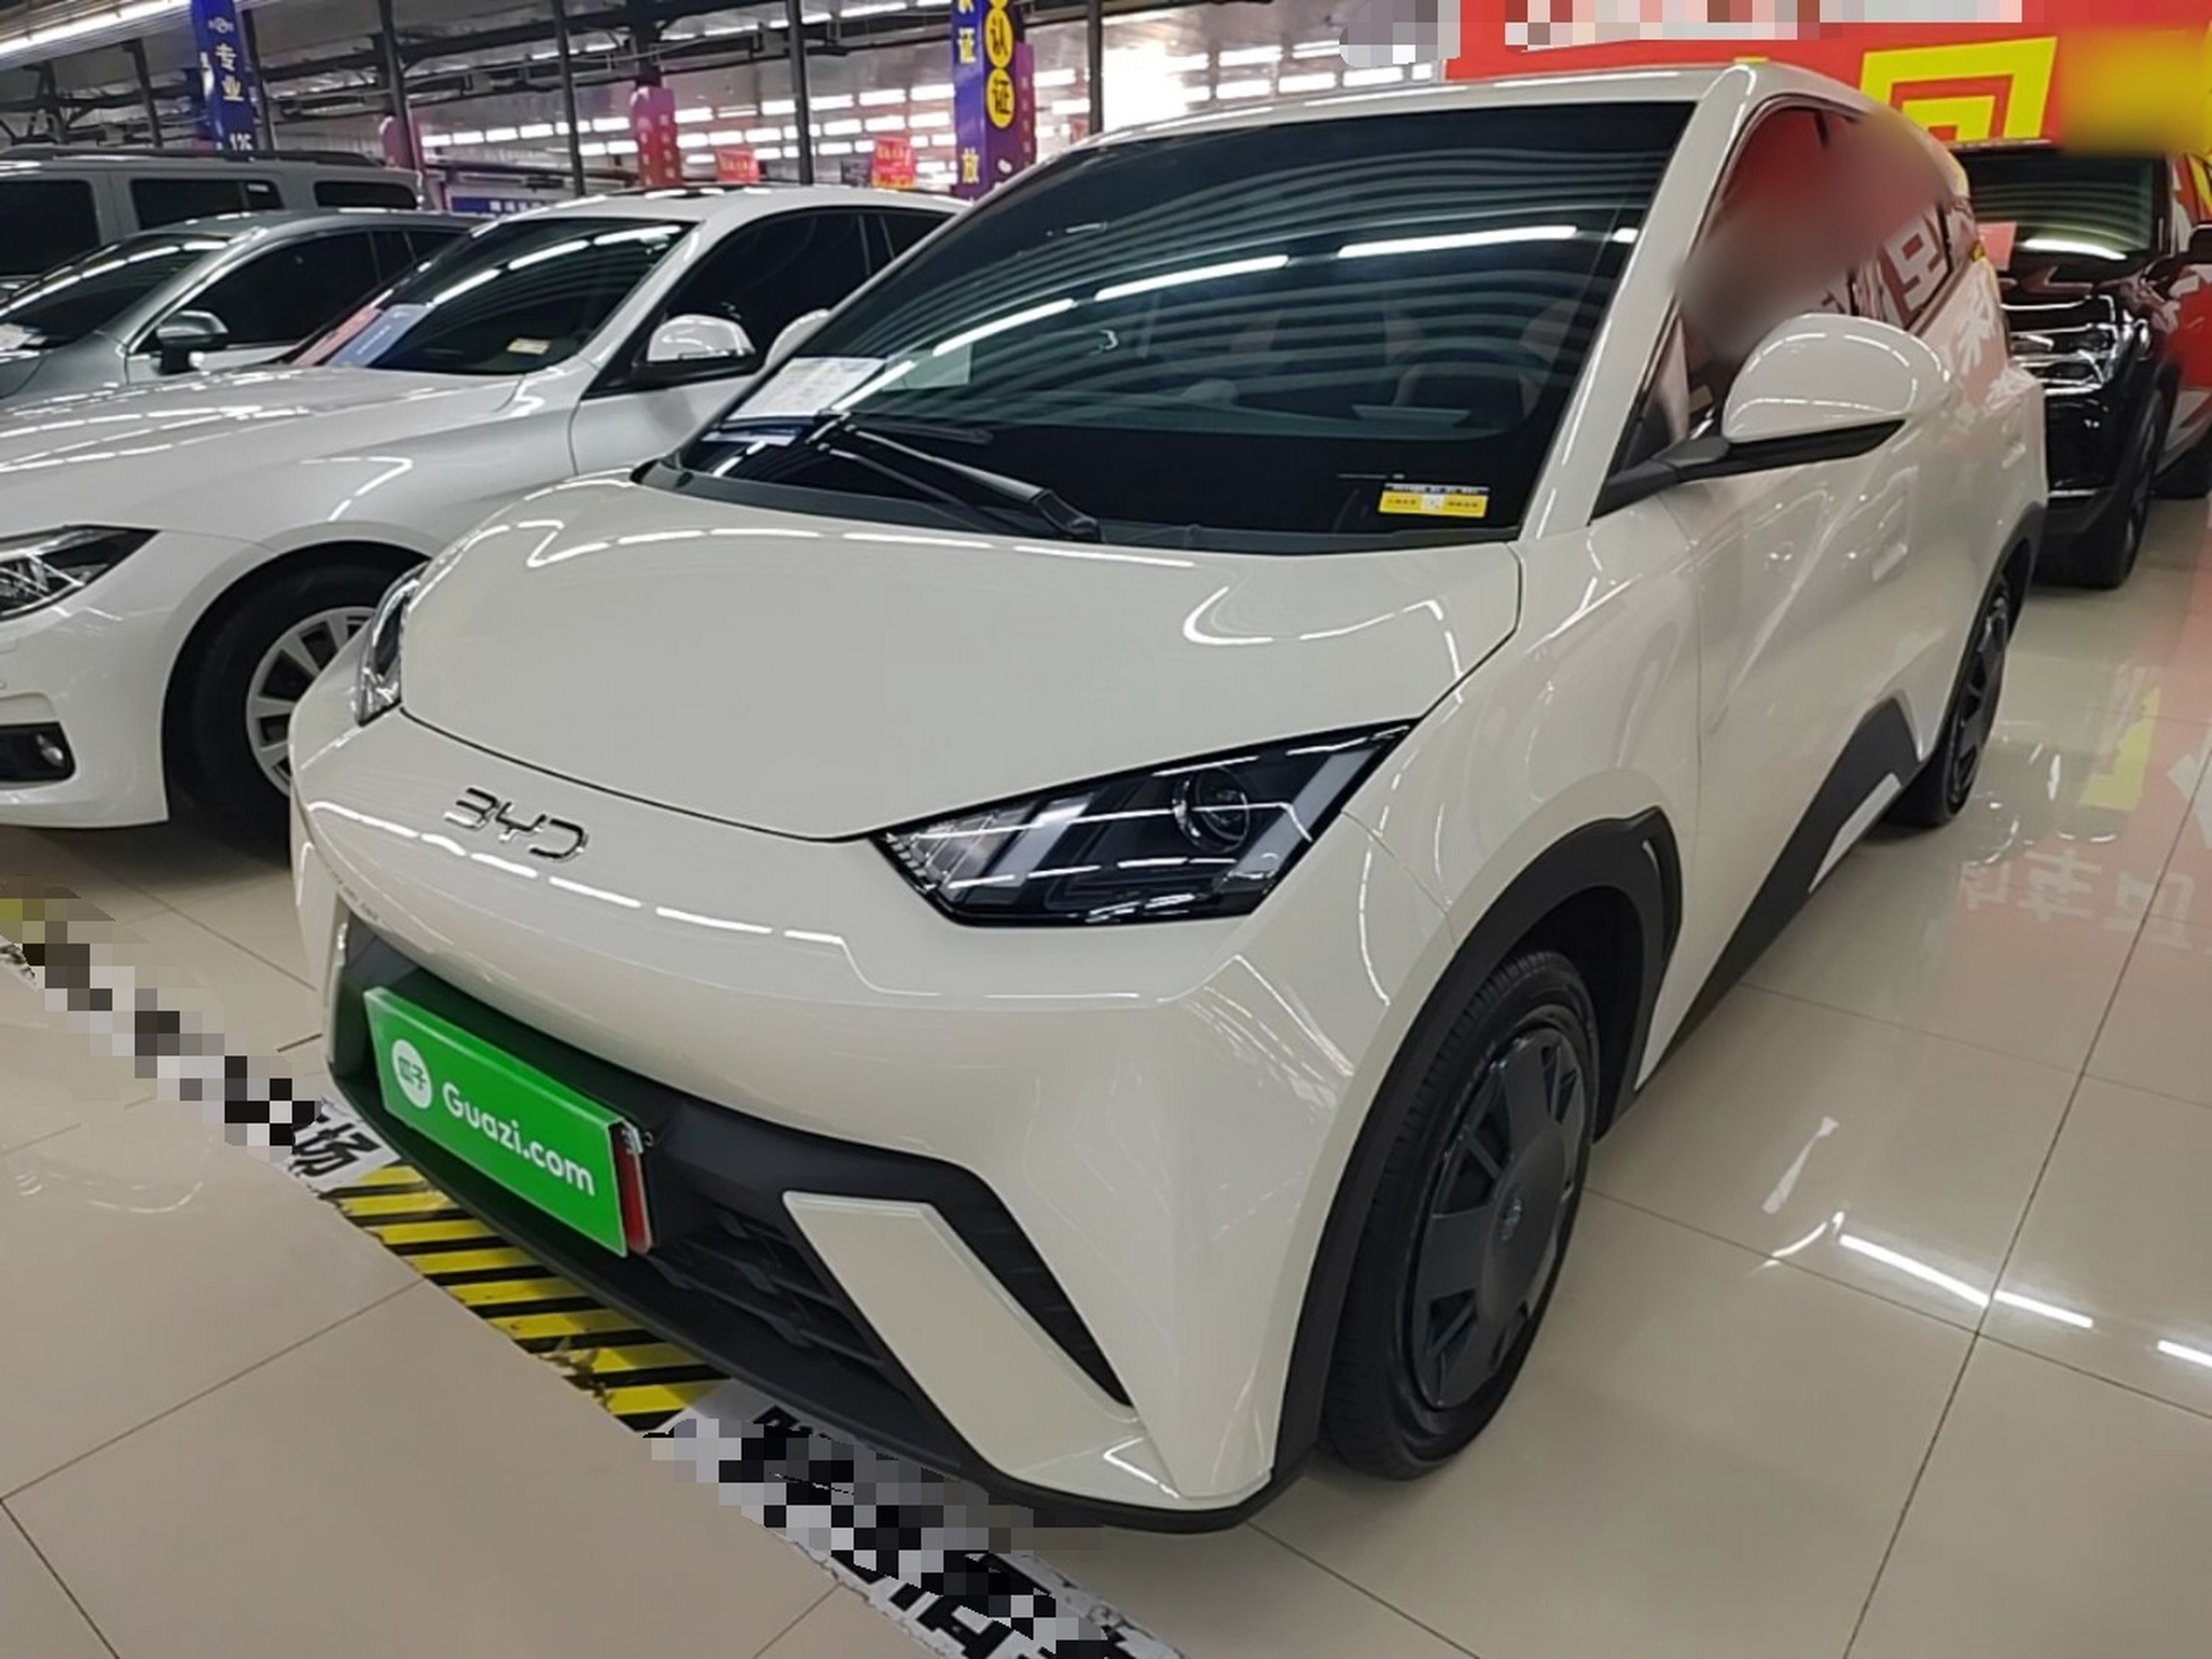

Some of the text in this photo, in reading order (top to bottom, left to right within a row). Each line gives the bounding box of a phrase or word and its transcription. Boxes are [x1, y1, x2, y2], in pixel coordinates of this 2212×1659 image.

[215, 43, 245, 102] 专业
[443, 786, 588, 862] BYD
[442, 1081, 595, 1196] Guazi.com
